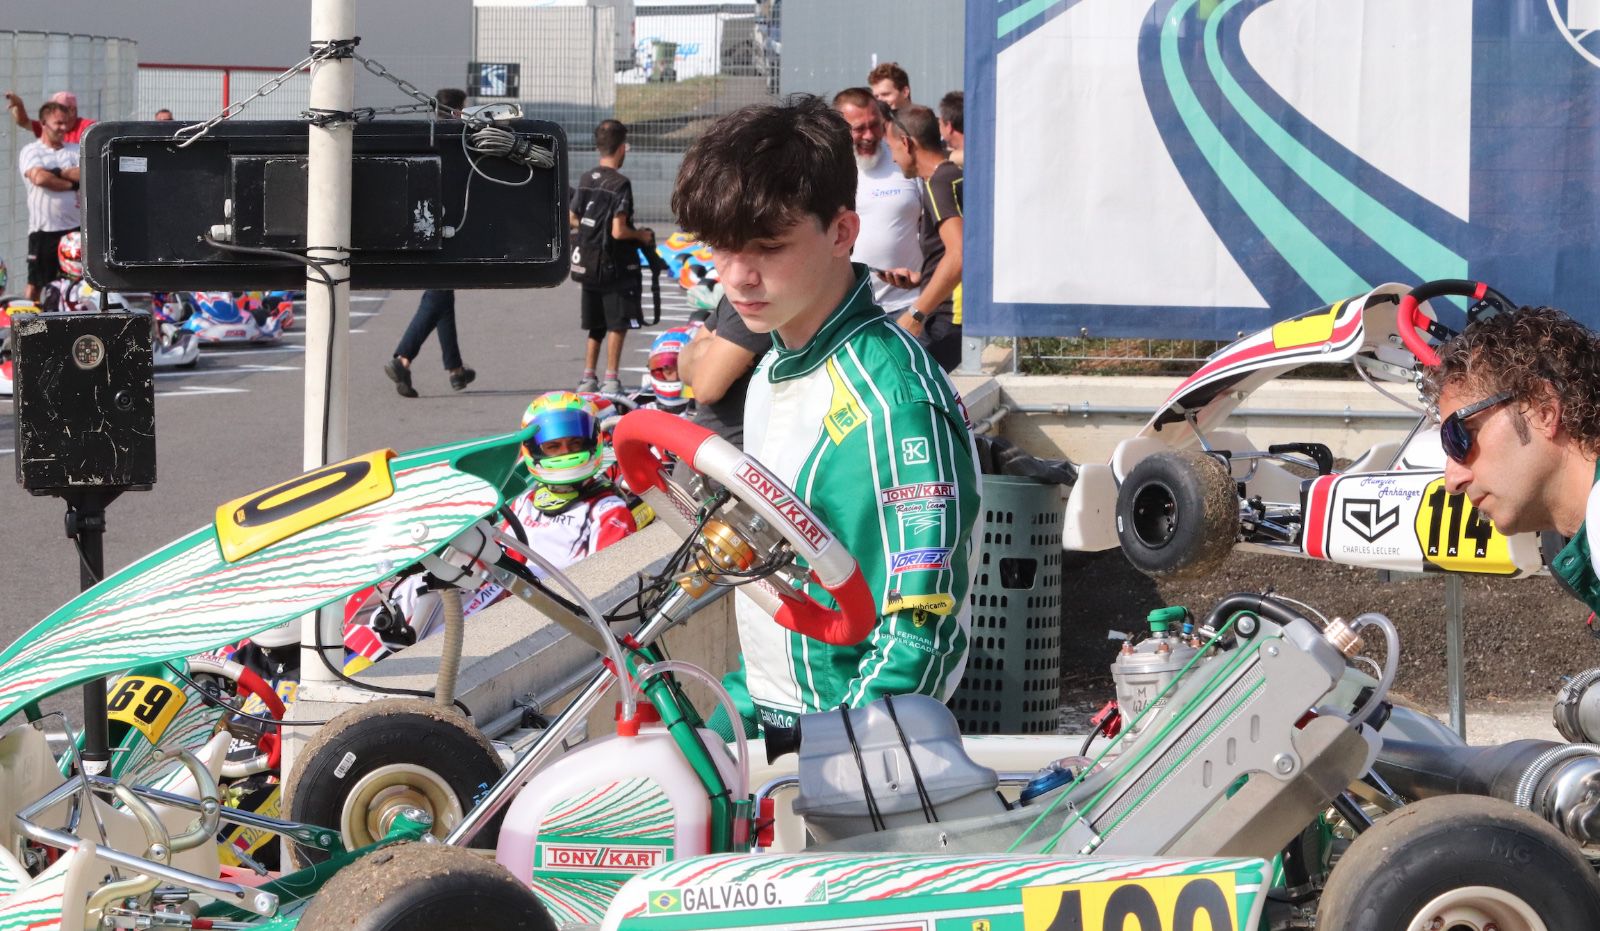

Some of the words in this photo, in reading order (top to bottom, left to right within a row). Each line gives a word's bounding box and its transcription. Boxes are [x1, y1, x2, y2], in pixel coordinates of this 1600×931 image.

[896, 503, 923, 513] Racing
[926, 501, 946, 510] team
[1428, 485, 1493, 558] 114
[1343, 545, 1371, 555] CHARLES
[1372, 546, 1400, 556] LECLERC
[891, 552, 946, 572] VORTEX
[896, 631, 932, 646] FERRARI
[107, 679, 172, 724] 69
[683, 882, 758, 911] GALVÃO
[764, 885, 783, 905] G.
